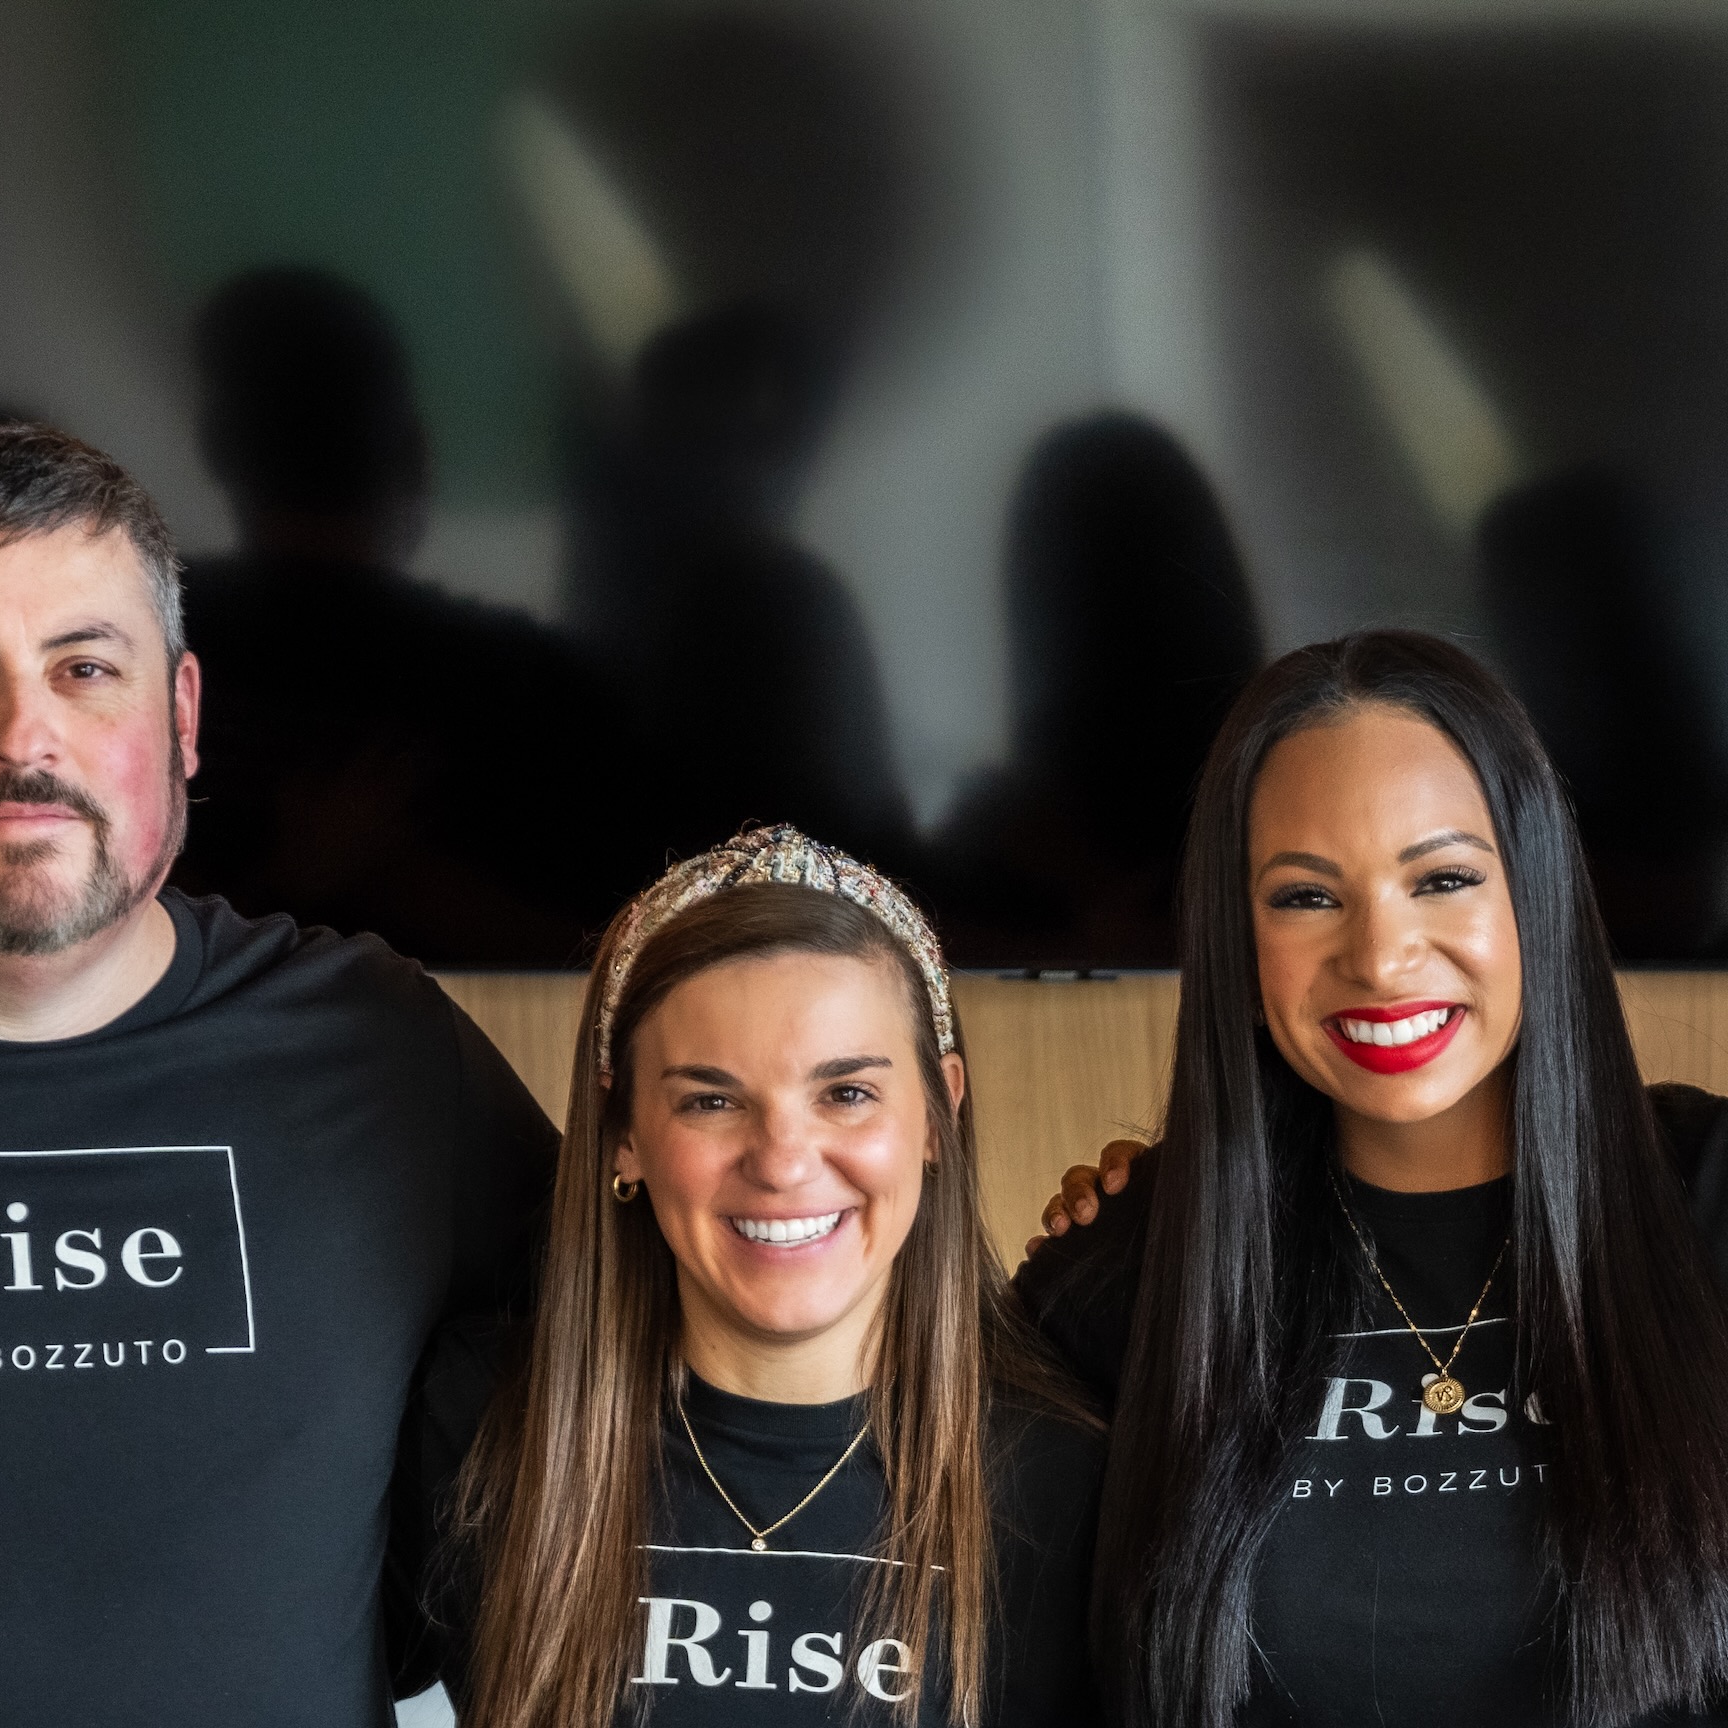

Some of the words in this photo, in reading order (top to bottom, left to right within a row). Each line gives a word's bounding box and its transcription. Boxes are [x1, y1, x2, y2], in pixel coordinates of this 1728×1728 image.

[1292, 1478, 1344, 1498] BY
[1373, 1463, 1549, 1496] BOZZUT
[630, 1597, 920, 1703] Rise
